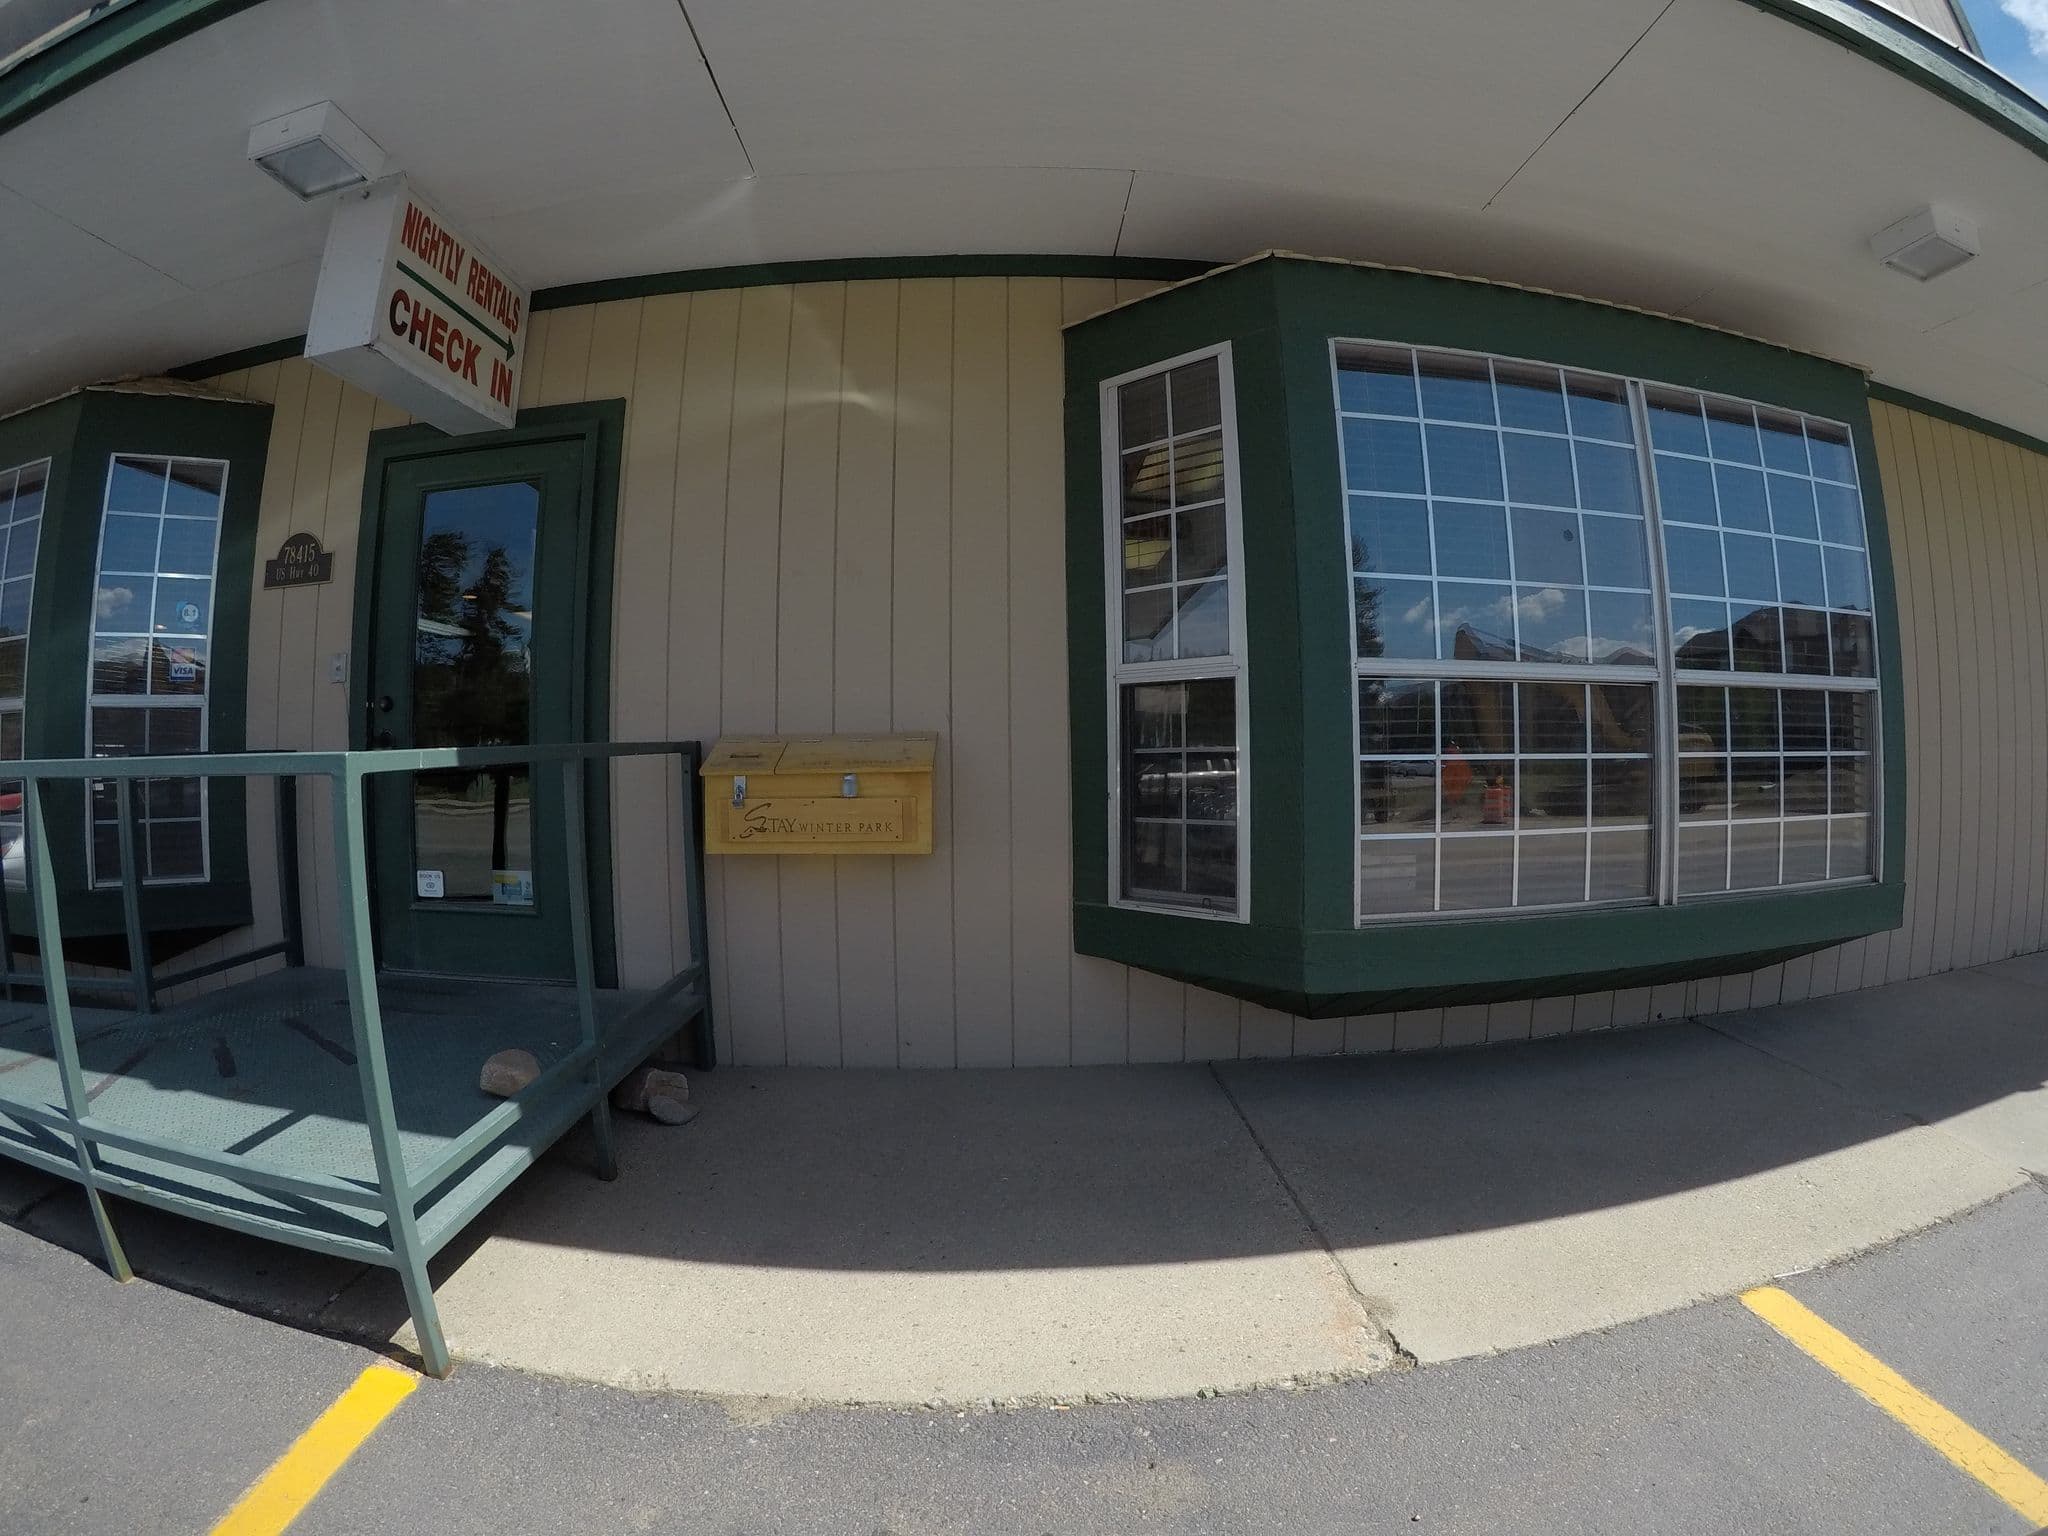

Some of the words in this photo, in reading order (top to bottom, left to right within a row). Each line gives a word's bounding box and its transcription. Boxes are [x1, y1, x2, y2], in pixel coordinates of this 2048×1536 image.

[401, 201, 465, 285] NIGHTLY
[466, 256, 521, 335] RENTALS
[389, 288, 482, 387] CHECK
[490, 358, 513, 408] IN
[284, 543, 316, 565] 78415
[276, 567, 287, 581] US
[308, 563, 320, 577] 40
[174, 666, 193, 675] VISA
[798, 822, 852, 833] WINTER
[858, 822, 893, 833] PARK
